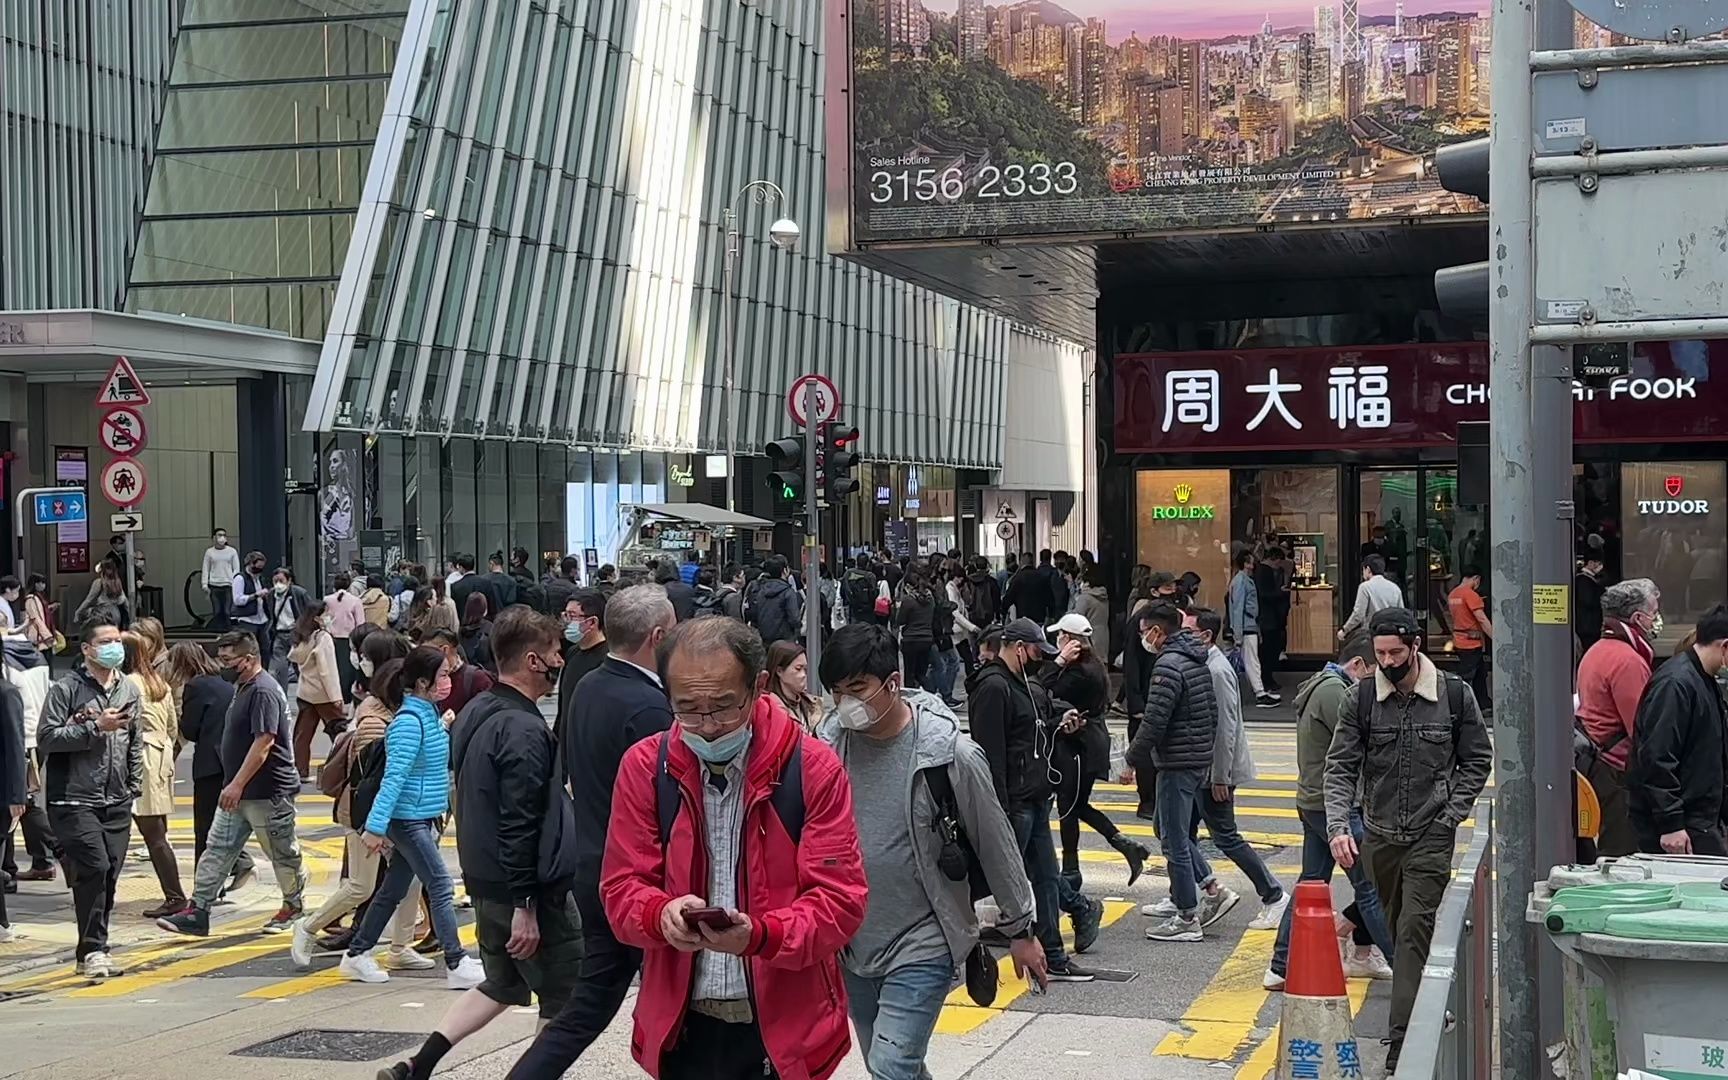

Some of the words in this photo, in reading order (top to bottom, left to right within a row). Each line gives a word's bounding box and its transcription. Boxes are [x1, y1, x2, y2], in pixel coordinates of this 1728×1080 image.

[870, 157, 896, 167] Sales
[898, 156, 930, 166] Hotline
[870, 168, 964, 203] 3156
[977, 161, 1078, 198] 2333
[1145, 178, 1179, 188] CHEUNG
[1180, 177, 1203, 186] KONG
[1204, 175, 1242, 185] PROPERTY
[1243, 171, 1300, 181] DEVELOPMENT
[1301, 170, 1335, 179] LIMITED
[1161, 365, 1392, 433] 周大福
[1446, 383, 1491, 405] CH
[1610, 377, 1697, 401] FOOK
[1152, 505, 1215, 520] ROLEX
[1637, 499, 1710, 515] TUDOR
[1287, 1038, 1362, 1080] 警察
[1701, 1044, 1725, 1070] 玻
